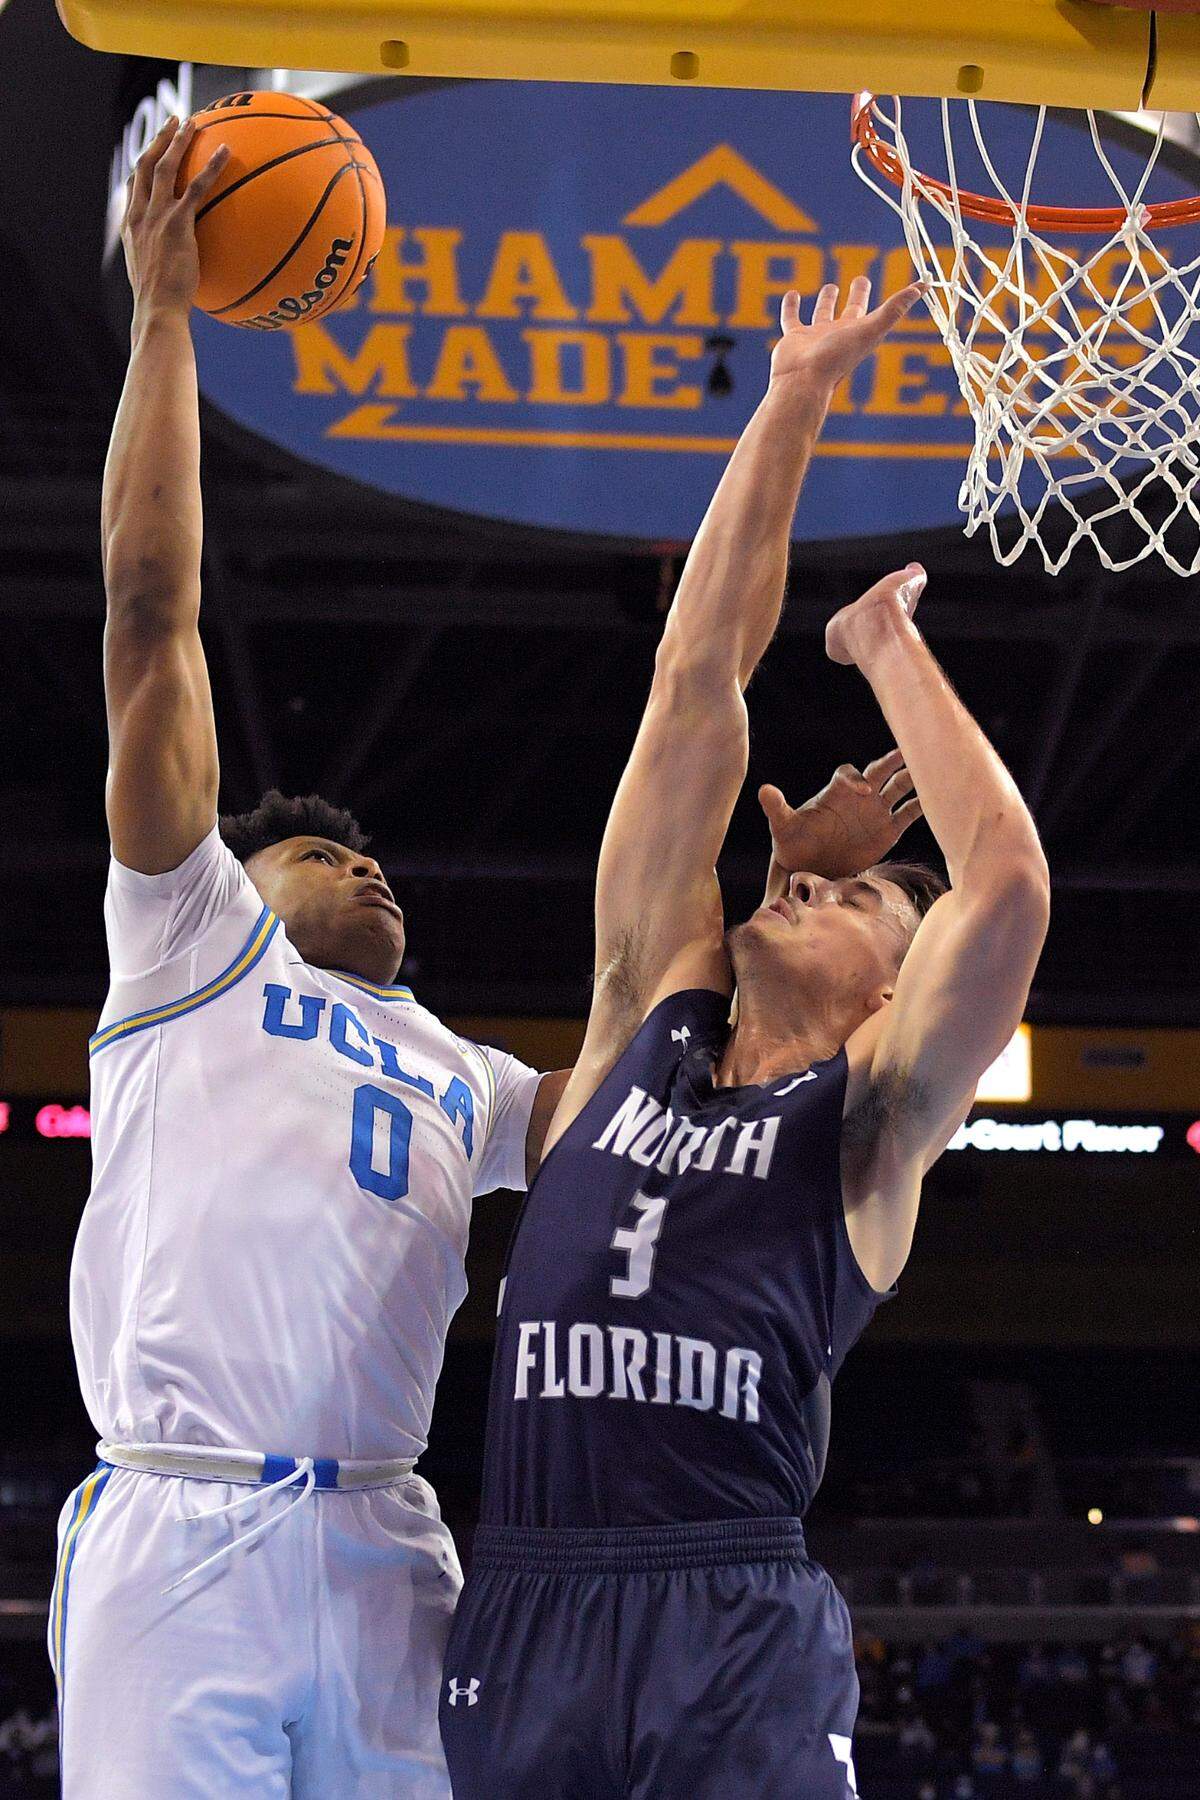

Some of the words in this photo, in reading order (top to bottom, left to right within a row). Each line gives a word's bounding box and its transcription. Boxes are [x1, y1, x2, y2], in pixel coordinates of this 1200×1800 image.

[338, 226, 1171, 335] HAMPIONS
[291, 320, 703, 409] MADE
[262, 983, 474, 1162] UCLA
[349, 1083, 413, 1201] 0
[592, 1085, 782, 1180] NORTH
[609, 1189, 670, 1300] 3
[514, 1320, 764, 1424] FLORIDA
